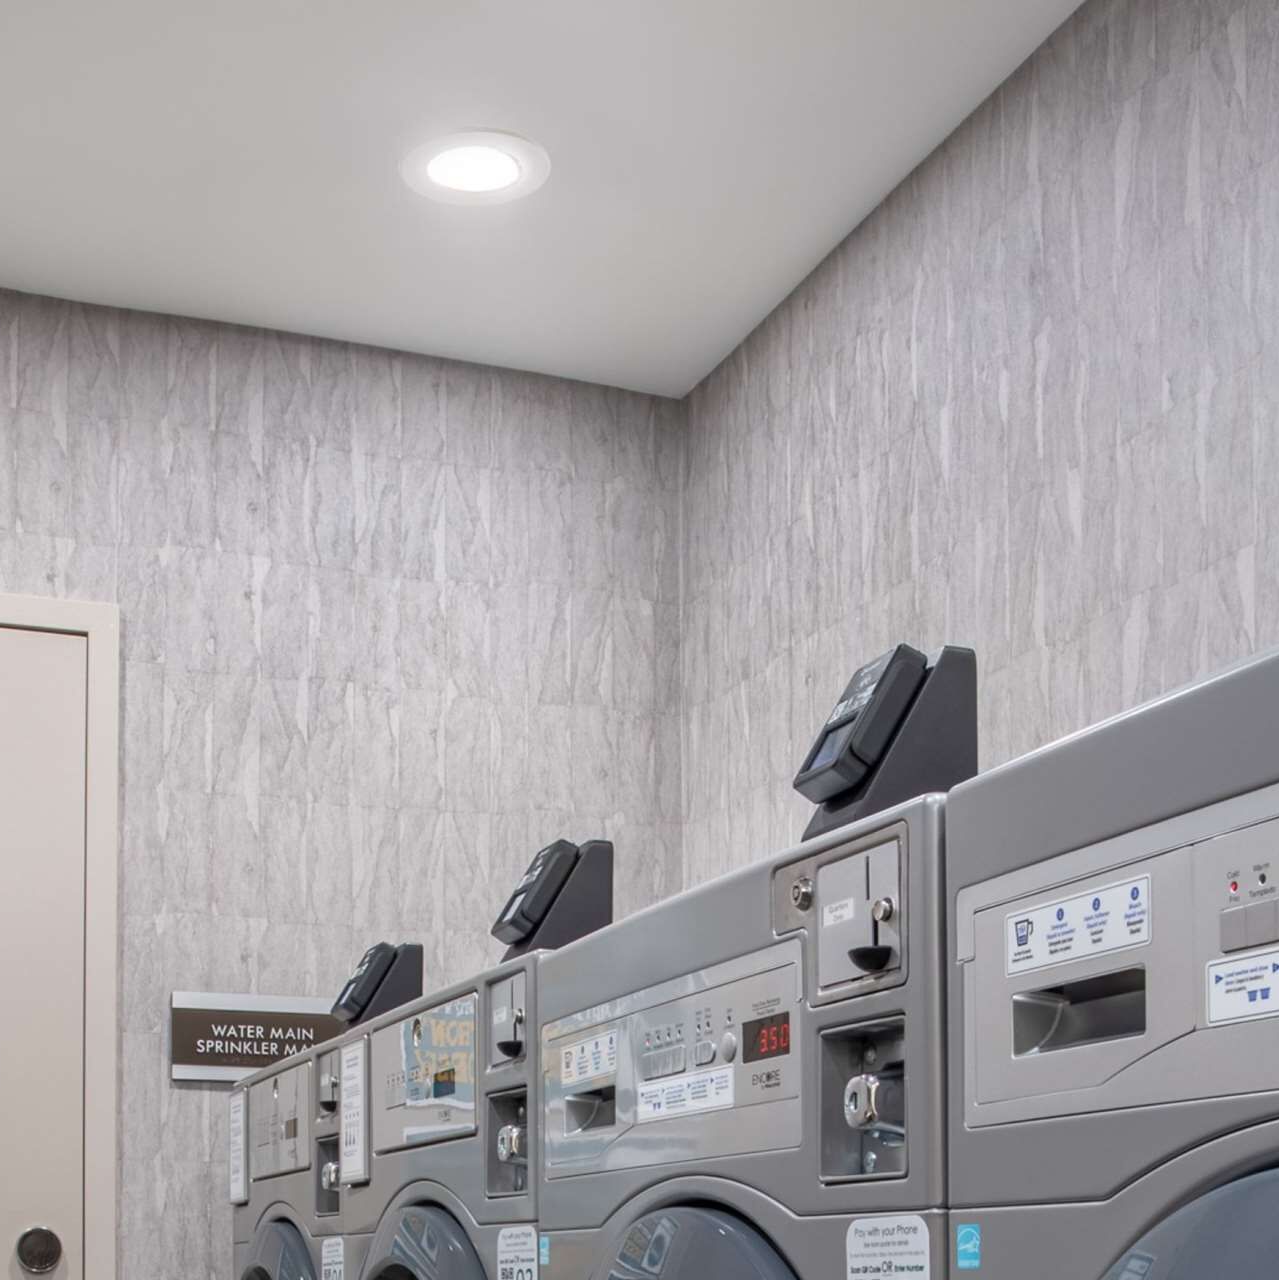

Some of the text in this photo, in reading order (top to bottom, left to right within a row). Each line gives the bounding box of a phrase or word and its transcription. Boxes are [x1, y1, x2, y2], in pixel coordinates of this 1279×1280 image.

[211, 1024, 314, 1040] WATER MAIN
[196, 1039, 278, 1056] SPRINKLER
